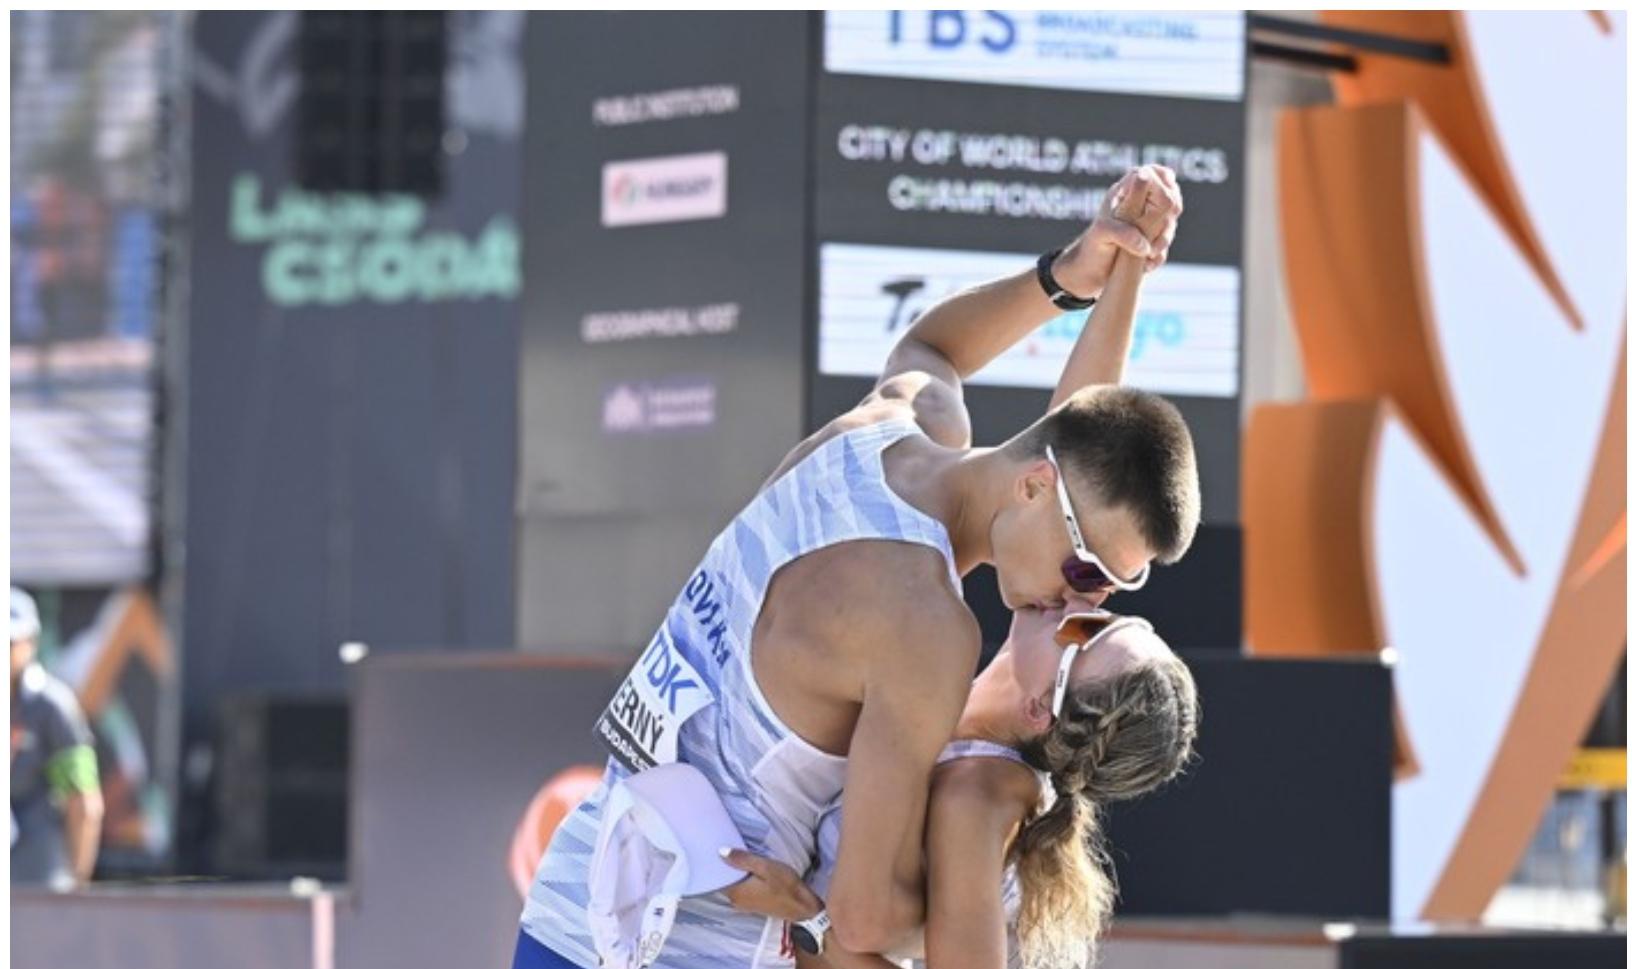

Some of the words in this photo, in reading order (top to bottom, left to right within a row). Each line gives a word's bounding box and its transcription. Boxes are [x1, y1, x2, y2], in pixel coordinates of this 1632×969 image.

[838, 124, 910, 161] CITY
[912, 130, 955, 164] OF
[959, 132, 1069, 173] WORLD
[642, 629, 699, 715] TDK
